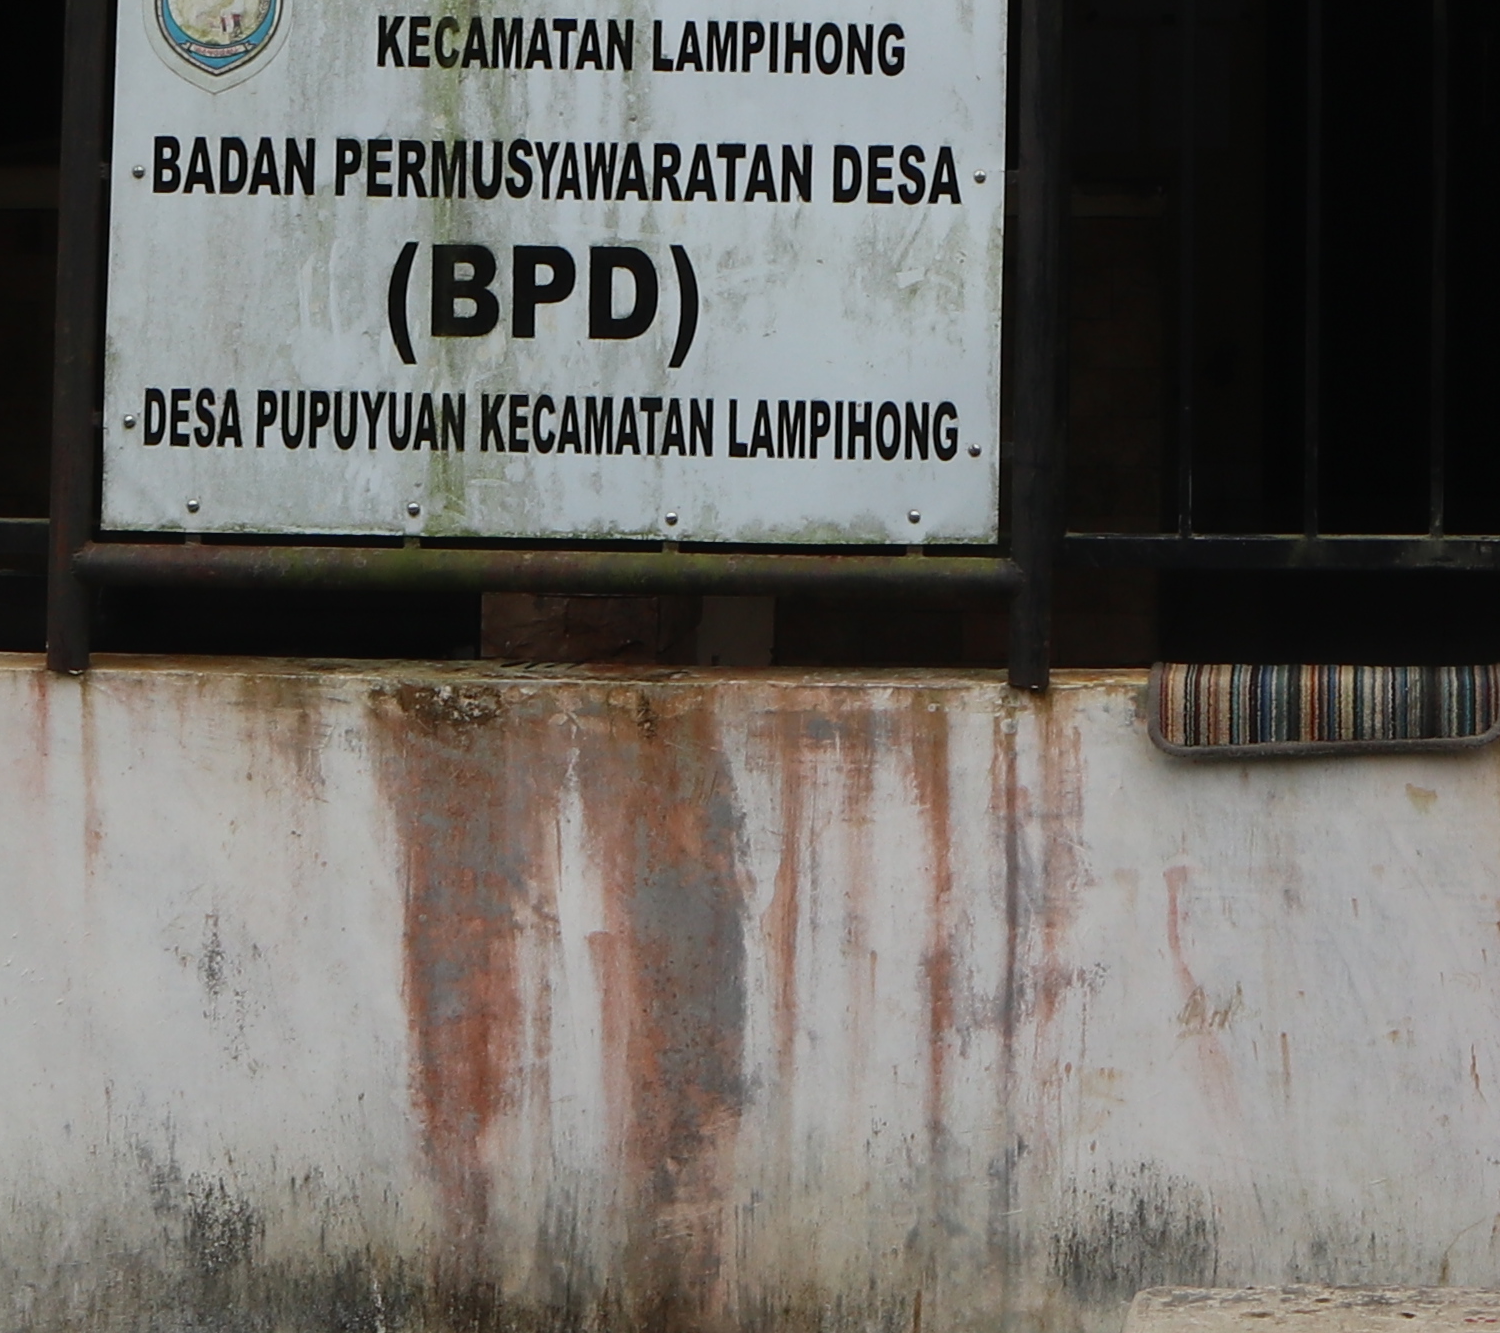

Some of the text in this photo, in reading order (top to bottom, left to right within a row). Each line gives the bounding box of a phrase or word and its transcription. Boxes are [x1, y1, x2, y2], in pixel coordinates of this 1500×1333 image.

[377, 15, 905, 77] KECAMATAN LAMPIHONG
[152, 135, 962, 205] BADAN PERMUSYAWARATAN DESA
[387, 241, 699, 369] (BPD)
[143, 387, 958, 462] DESA PUPUYUAN KECAMATAN LAMPIHONG
